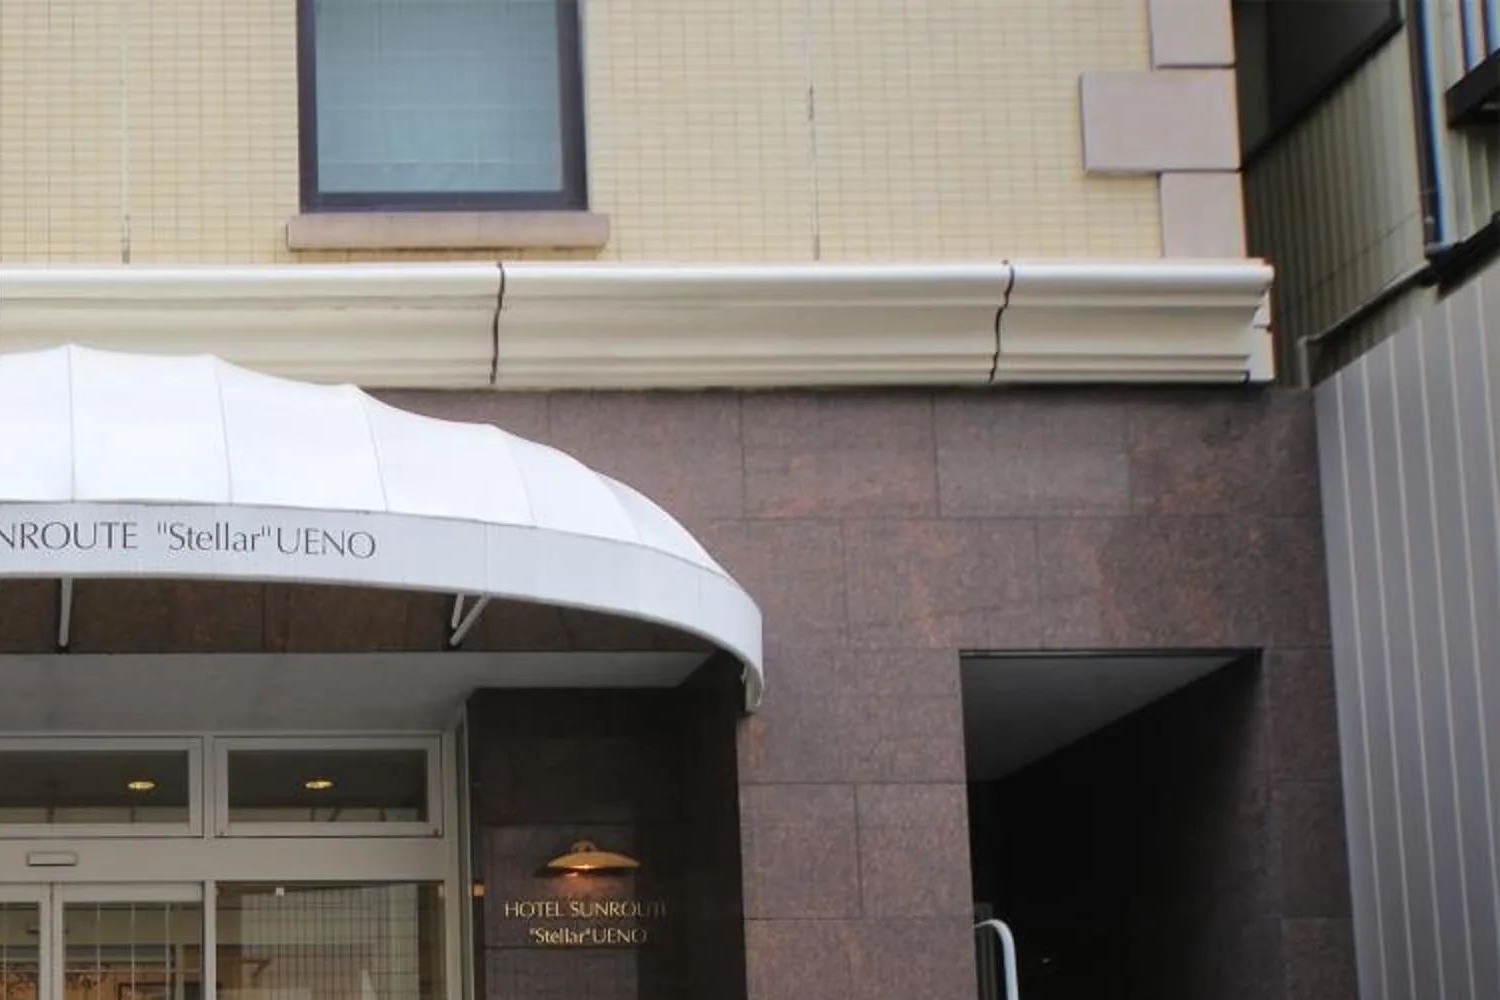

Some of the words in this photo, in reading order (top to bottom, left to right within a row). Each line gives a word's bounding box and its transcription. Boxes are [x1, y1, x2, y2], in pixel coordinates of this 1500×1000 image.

[276, 526, 377, 559] UENO
[504, 900, 565, 918] HOTEL
[592, 927, 648, 944] UENO
